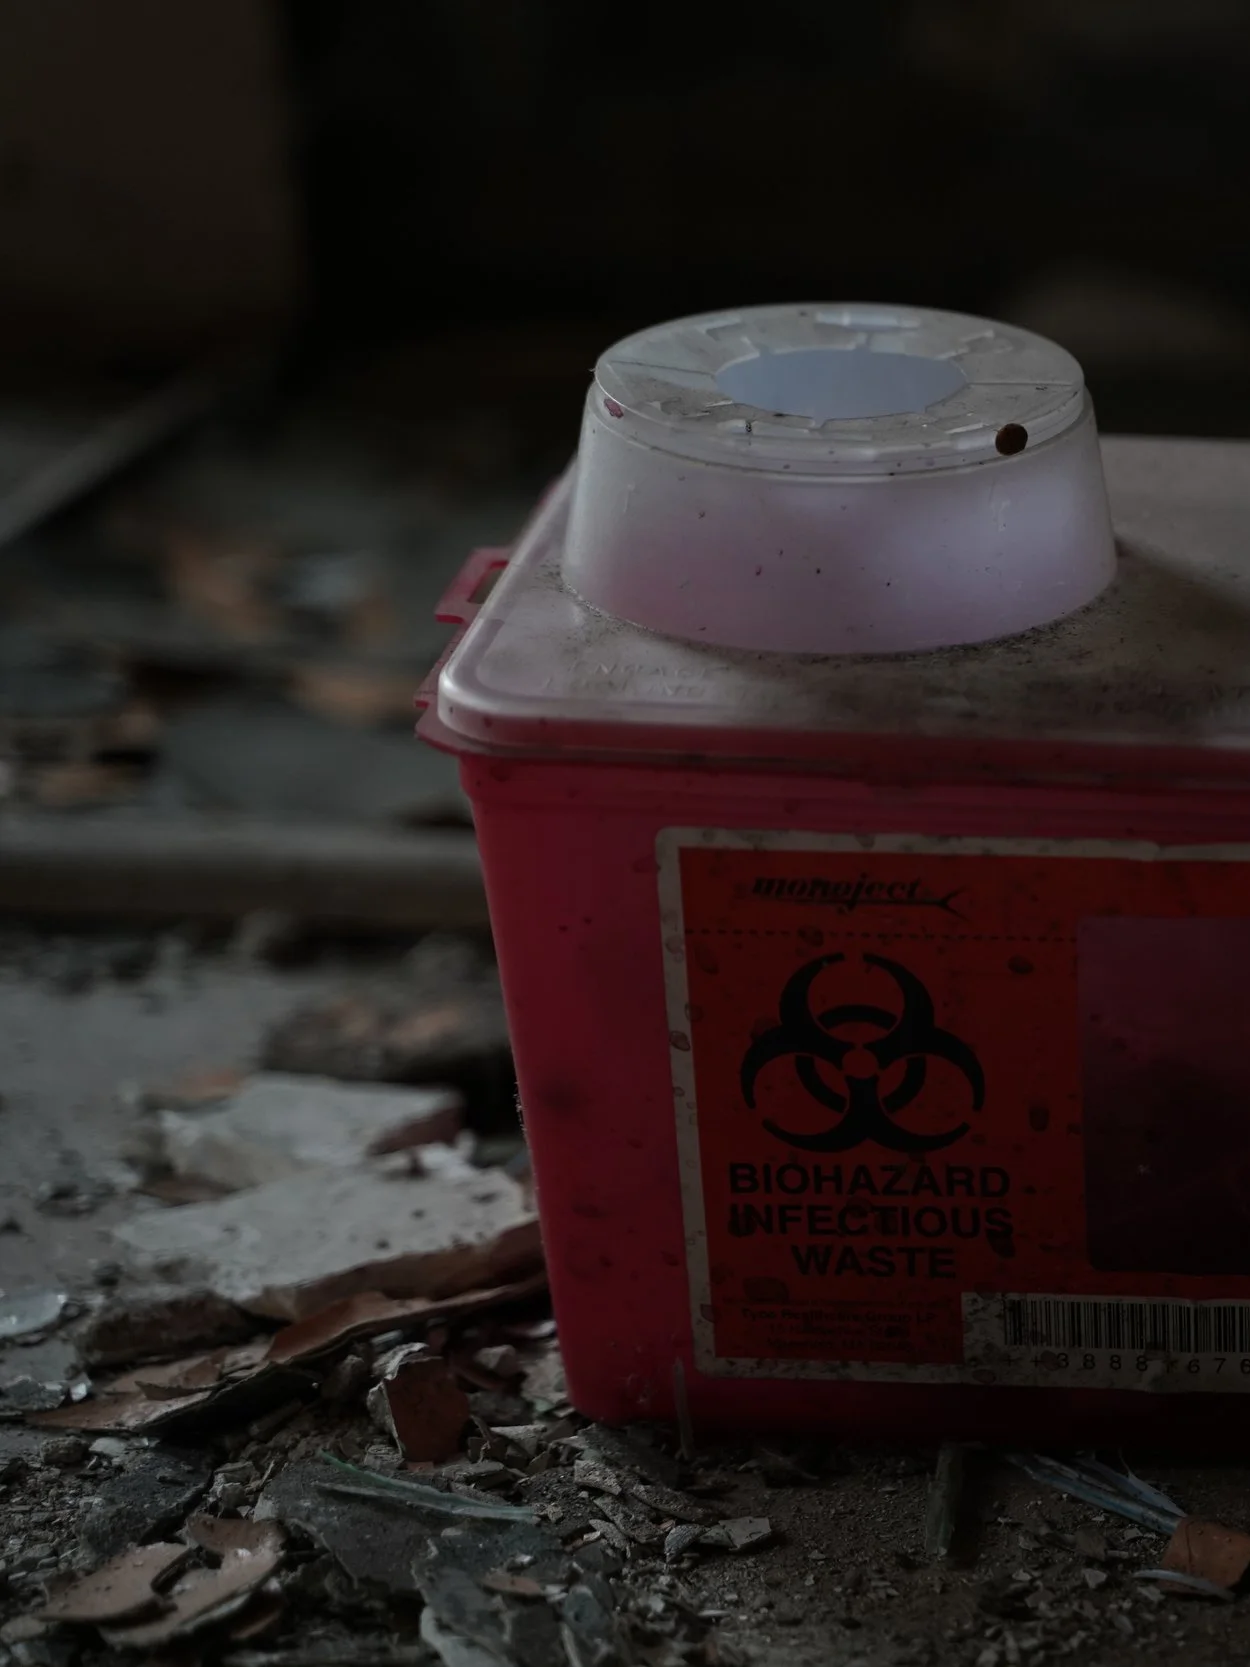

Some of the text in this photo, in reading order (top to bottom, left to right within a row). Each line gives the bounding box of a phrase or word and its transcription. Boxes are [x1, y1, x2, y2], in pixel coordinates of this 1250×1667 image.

[752, 872, 924, 913] monoject
[728, 1163, 1011, 1199] BIOHAZARD
[728, 1203, 1014, 1240] INFECTIOUS
[792, 1244, 957, 1280] WASTE
